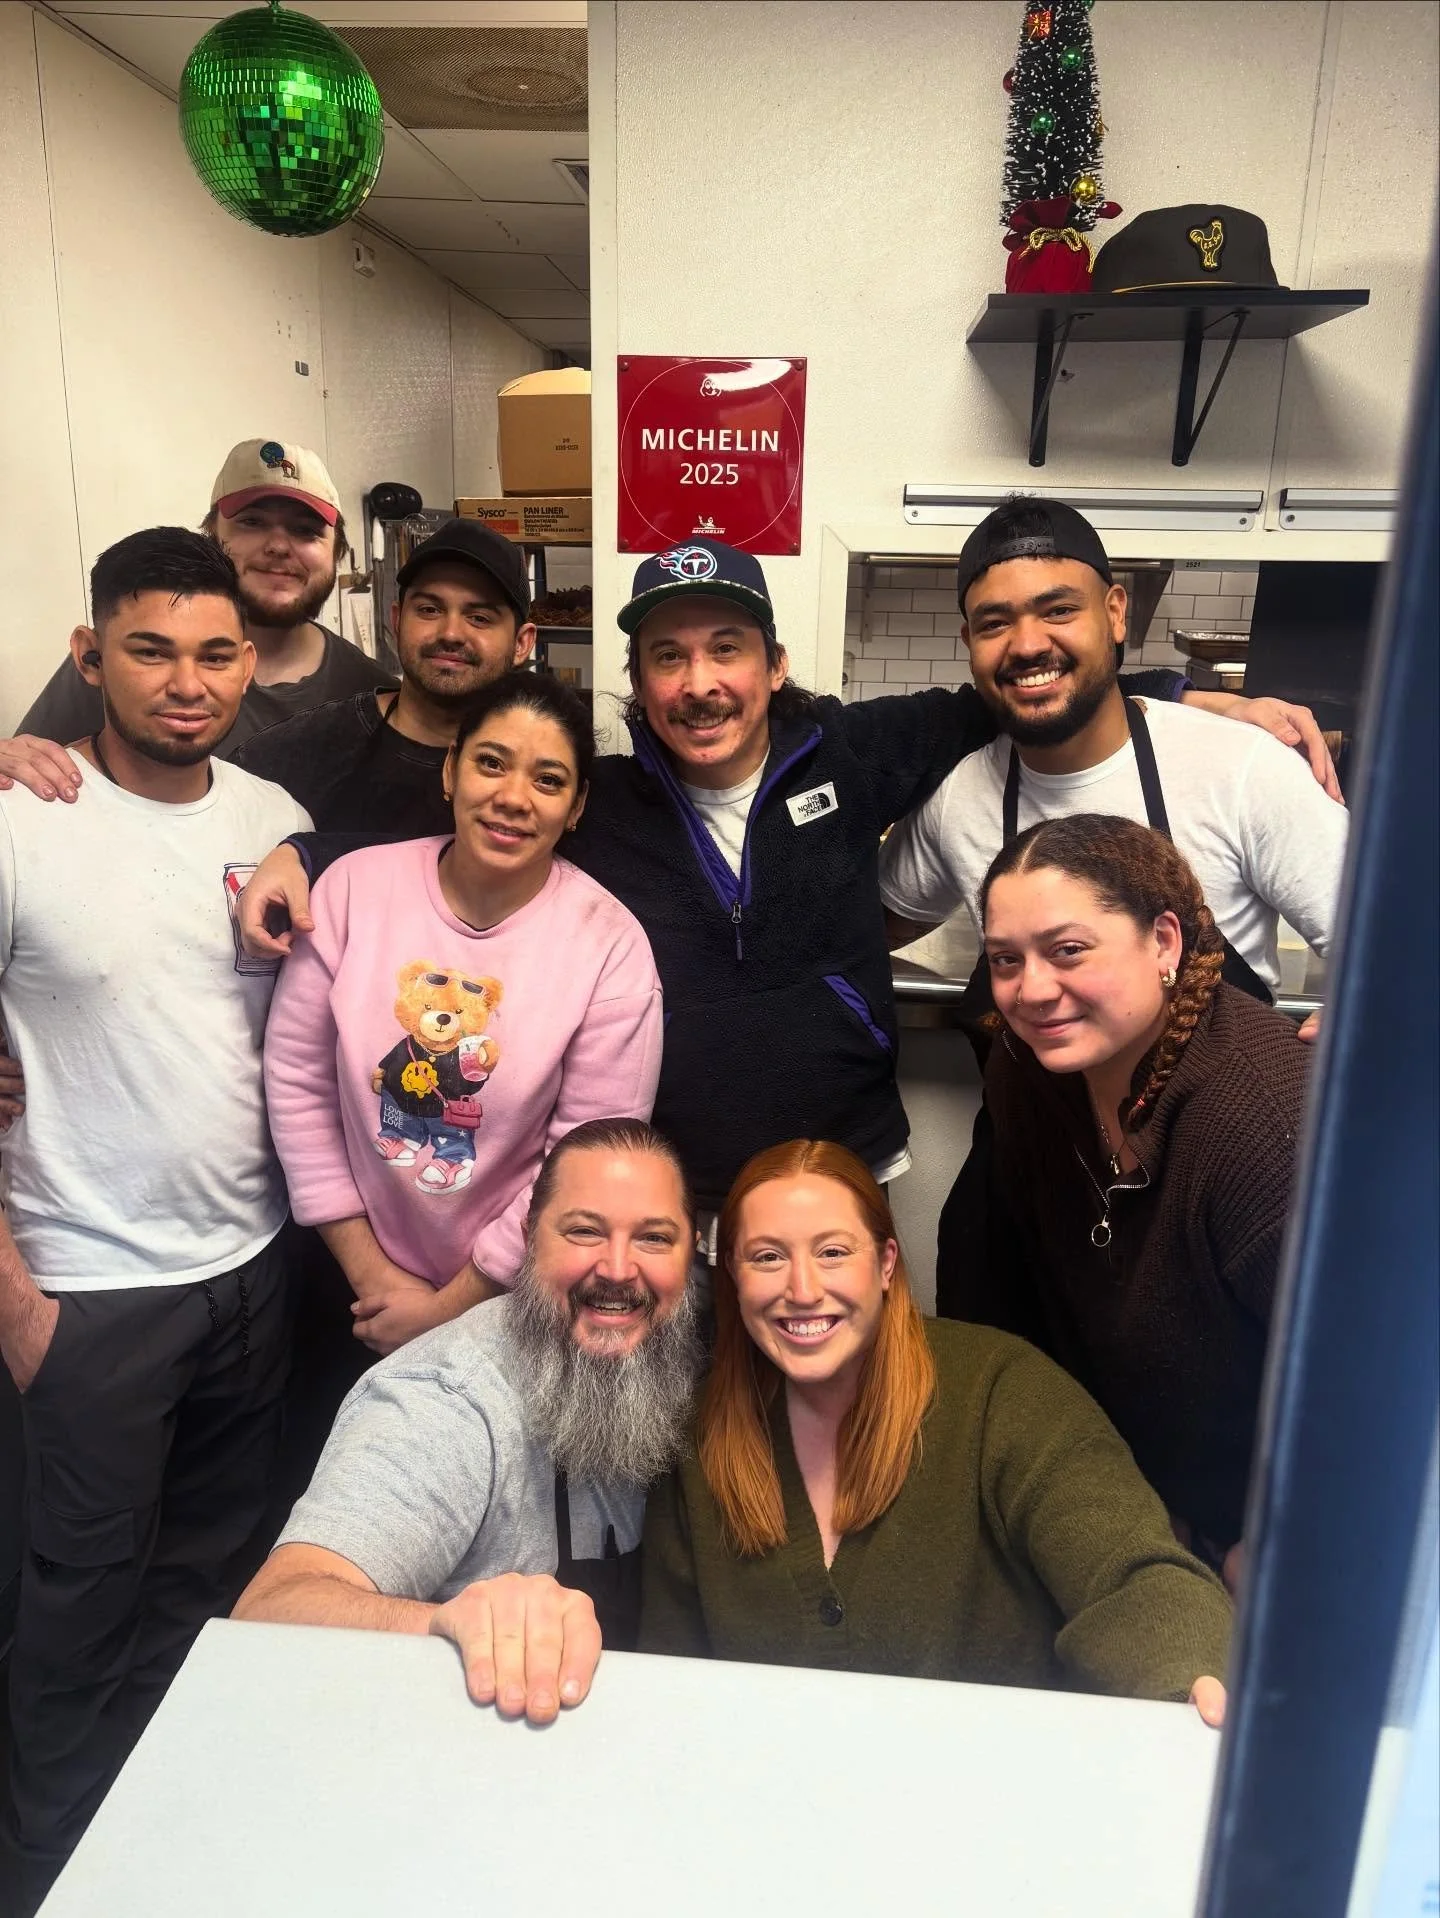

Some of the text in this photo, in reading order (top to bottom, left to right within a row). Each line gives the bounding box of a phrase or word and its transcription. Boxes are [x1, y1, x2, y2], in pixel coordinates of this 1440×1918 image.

[642, 428, 779, 452] MICHELIN
[679, 462, 739, 485] 2025
[477, 507, 505, 518] Sysco
[805, 793, 818, 803] THE
[797, 799, 820, 813] NORTH
[806, 805, 822, 817] FACE
[384, 1103, 403, 1116] LOVE
[383, 1116, 403, 1130] LOVE
[384, 1110, 403, 1123] LOVE
